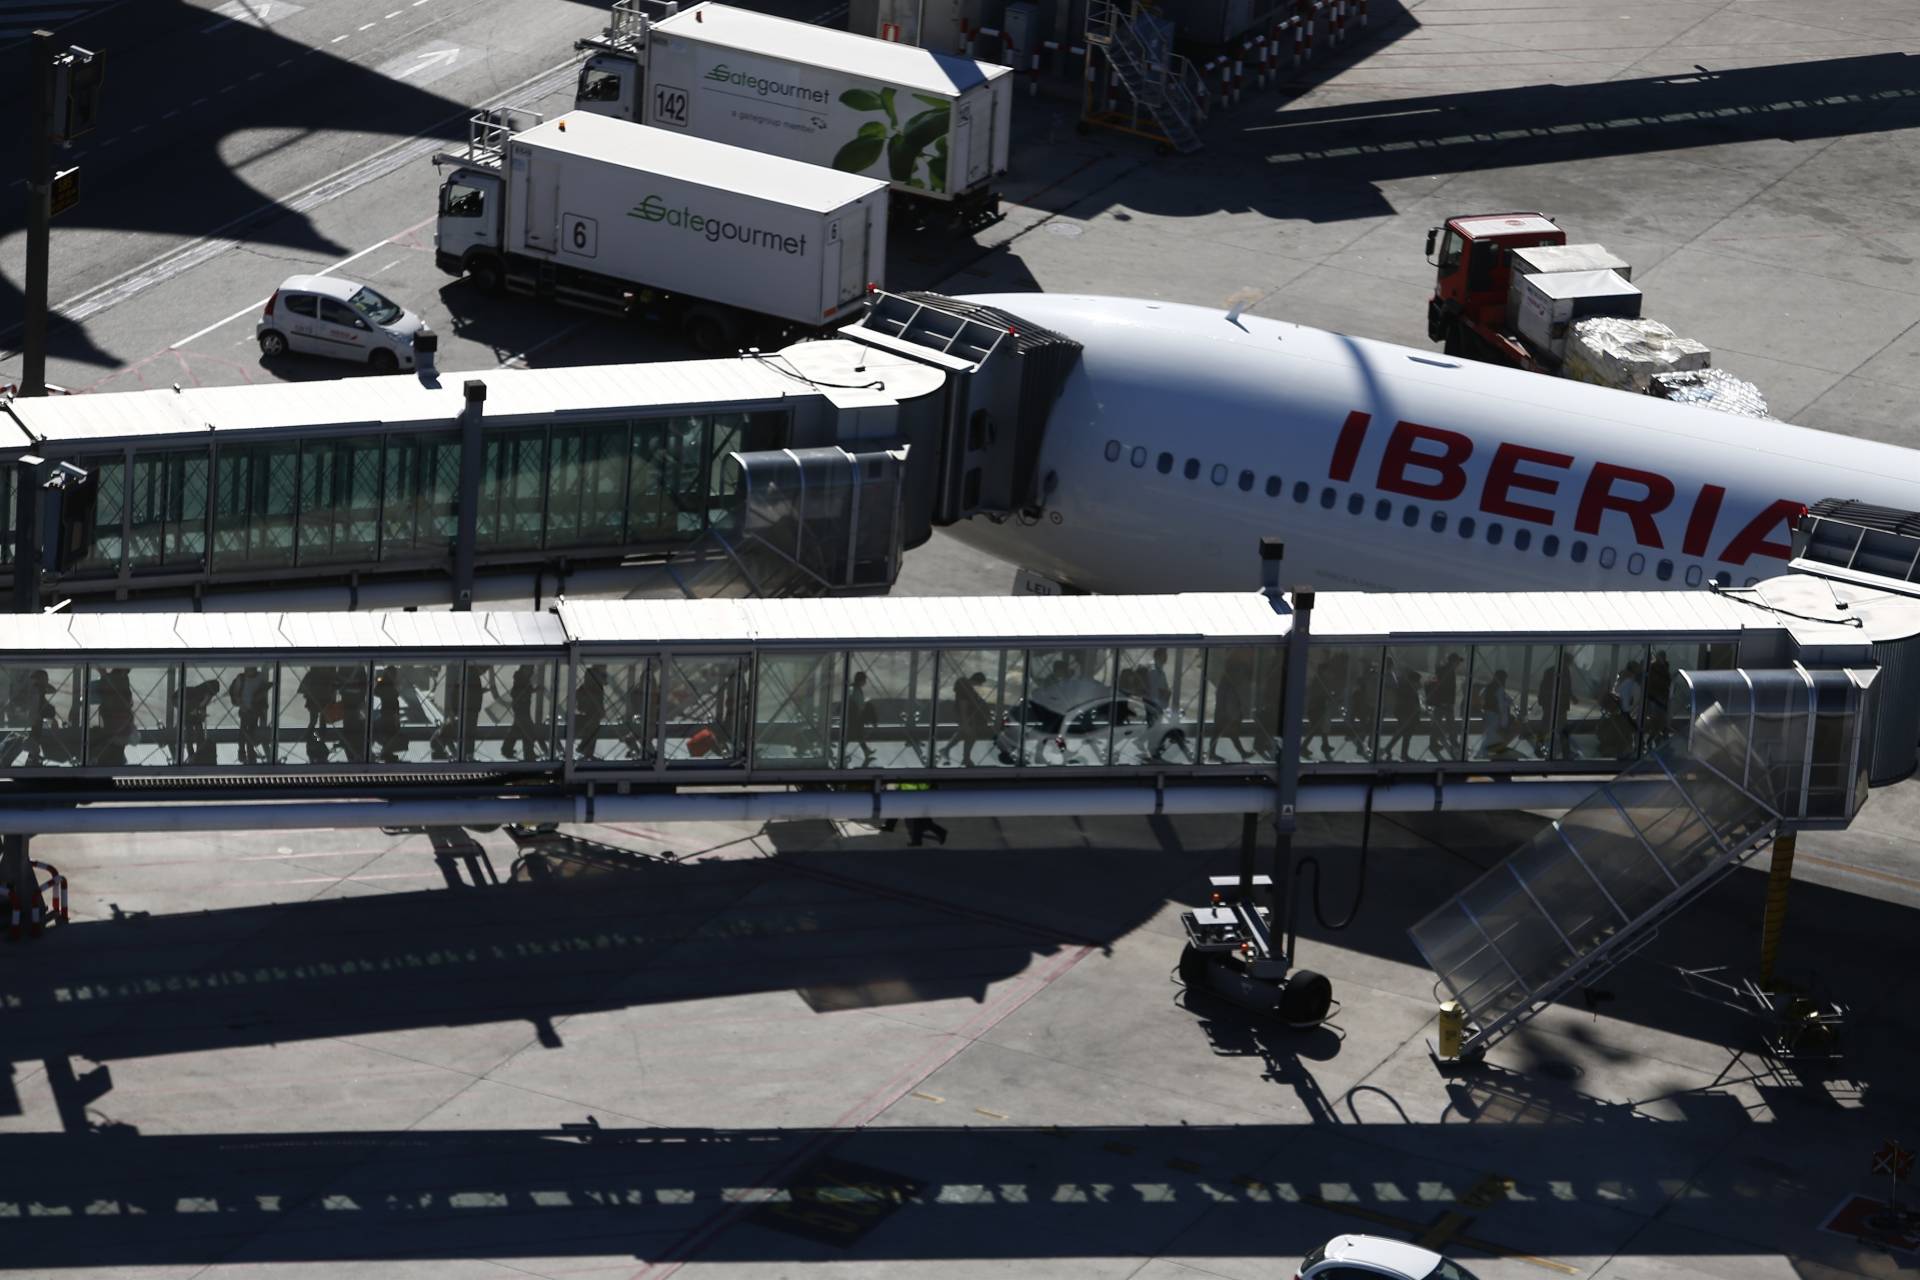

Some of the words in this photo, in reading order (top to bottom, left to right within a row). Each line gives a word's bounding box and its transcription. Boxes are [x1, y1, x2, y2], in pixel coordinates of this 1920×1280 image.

[657, 90, 686, 122] 142
[574, 221, 587, 249] 6
[1328, 410, 1808, 565] IBERIA
